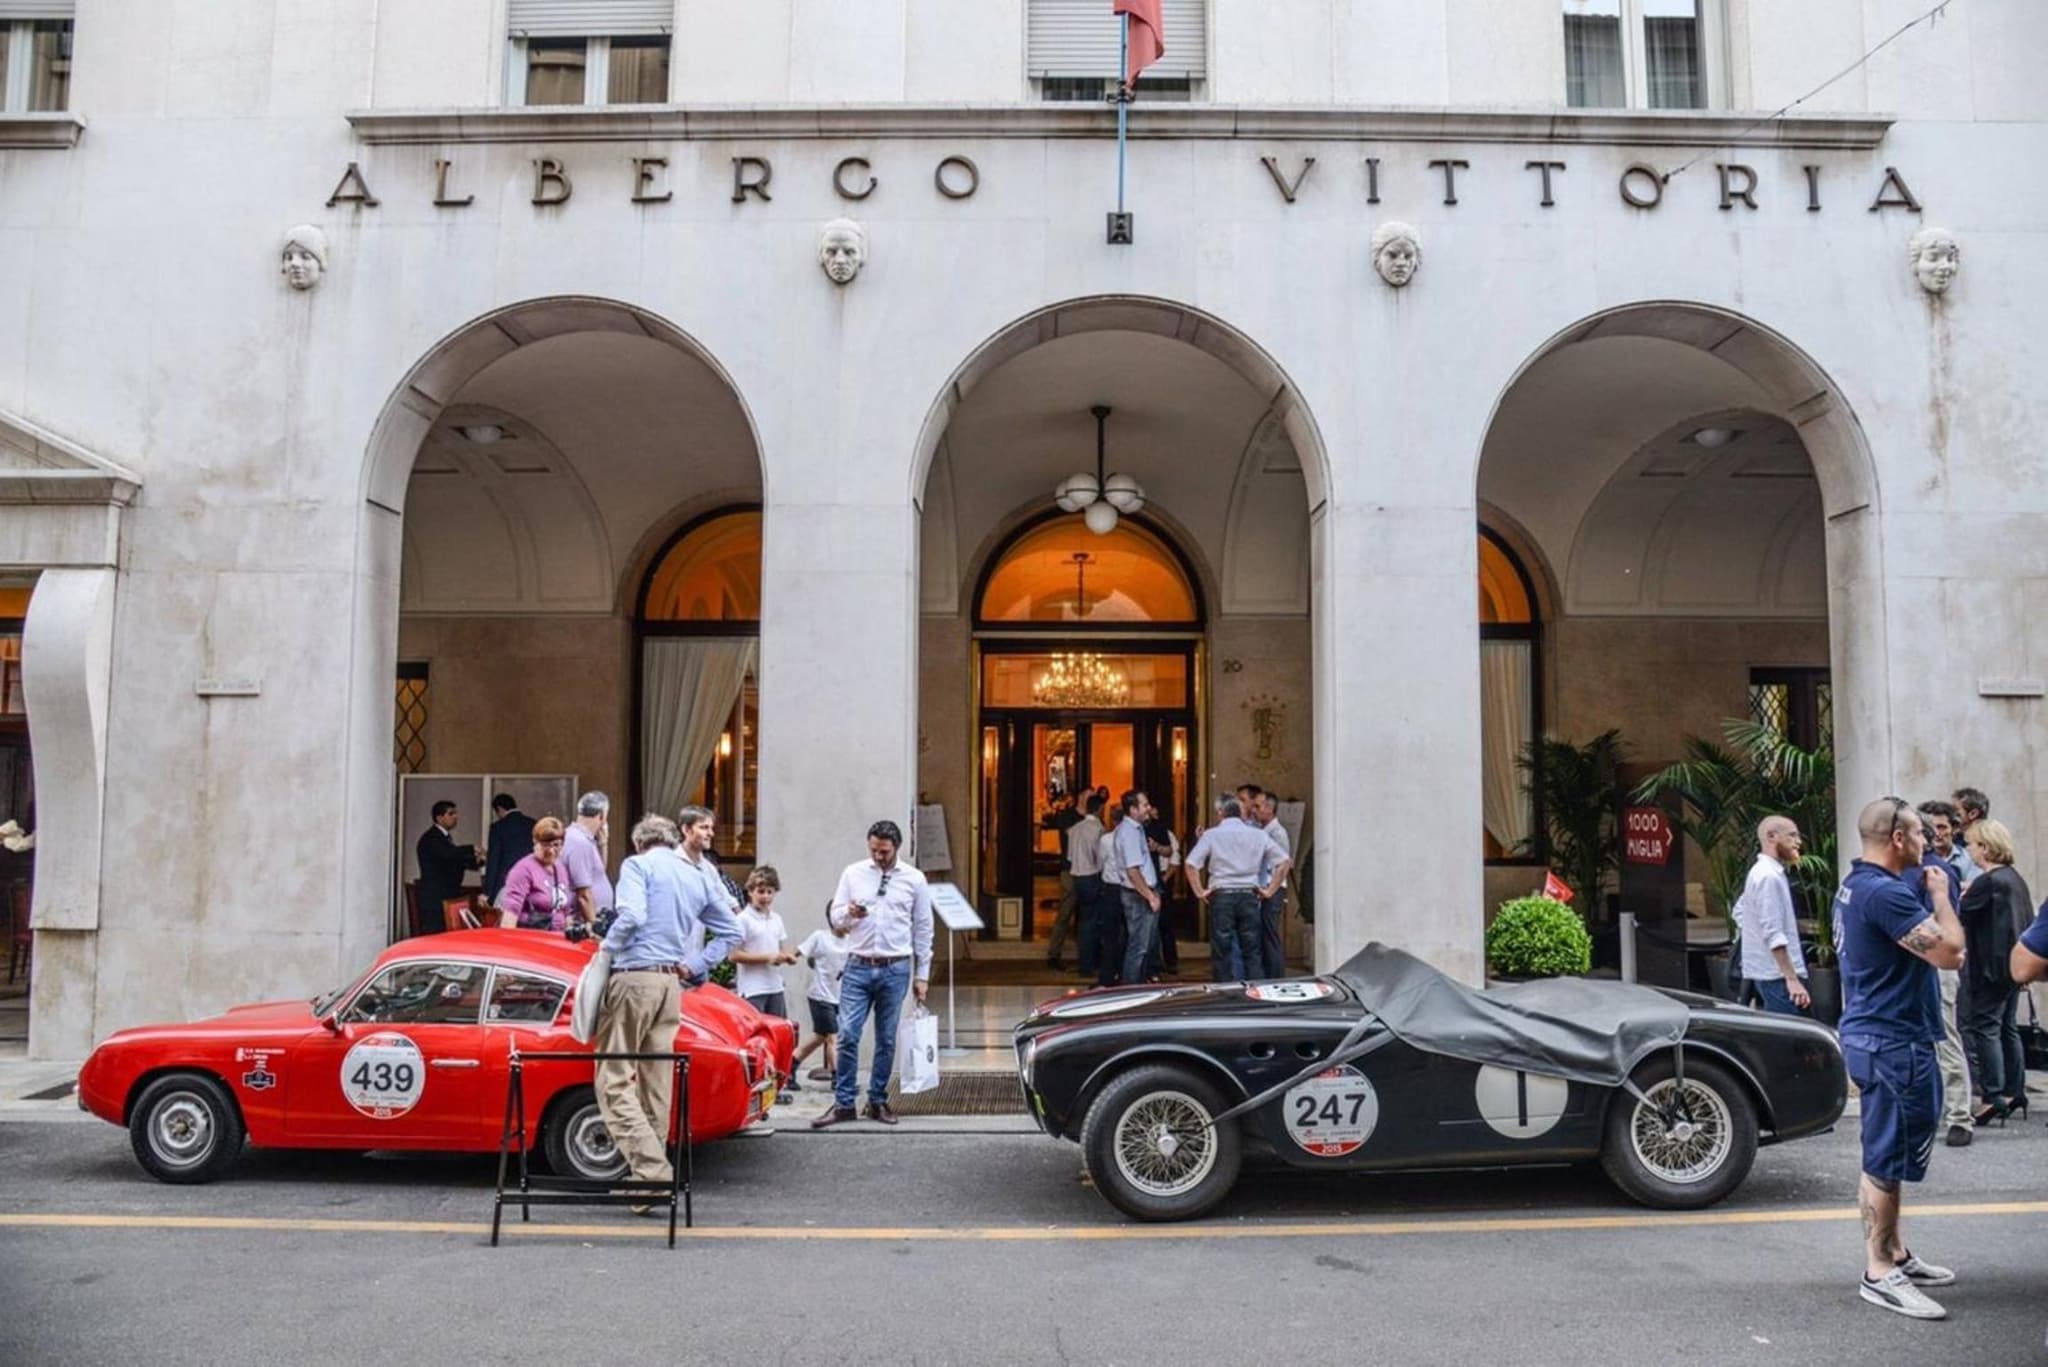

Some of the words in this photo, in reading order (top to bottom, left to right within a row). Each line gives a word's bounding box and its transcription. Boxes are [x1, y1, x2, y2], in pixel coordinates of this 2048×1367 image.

[1260, 157, 1922, 214] VITTORIA
[1629, 814, 1658, 831] 1000
[1628, 840, 1662, 857] MIGLIA
[351, 1061, 414, 1092] 439
[1295, 1092, 1367, 1127] 247
